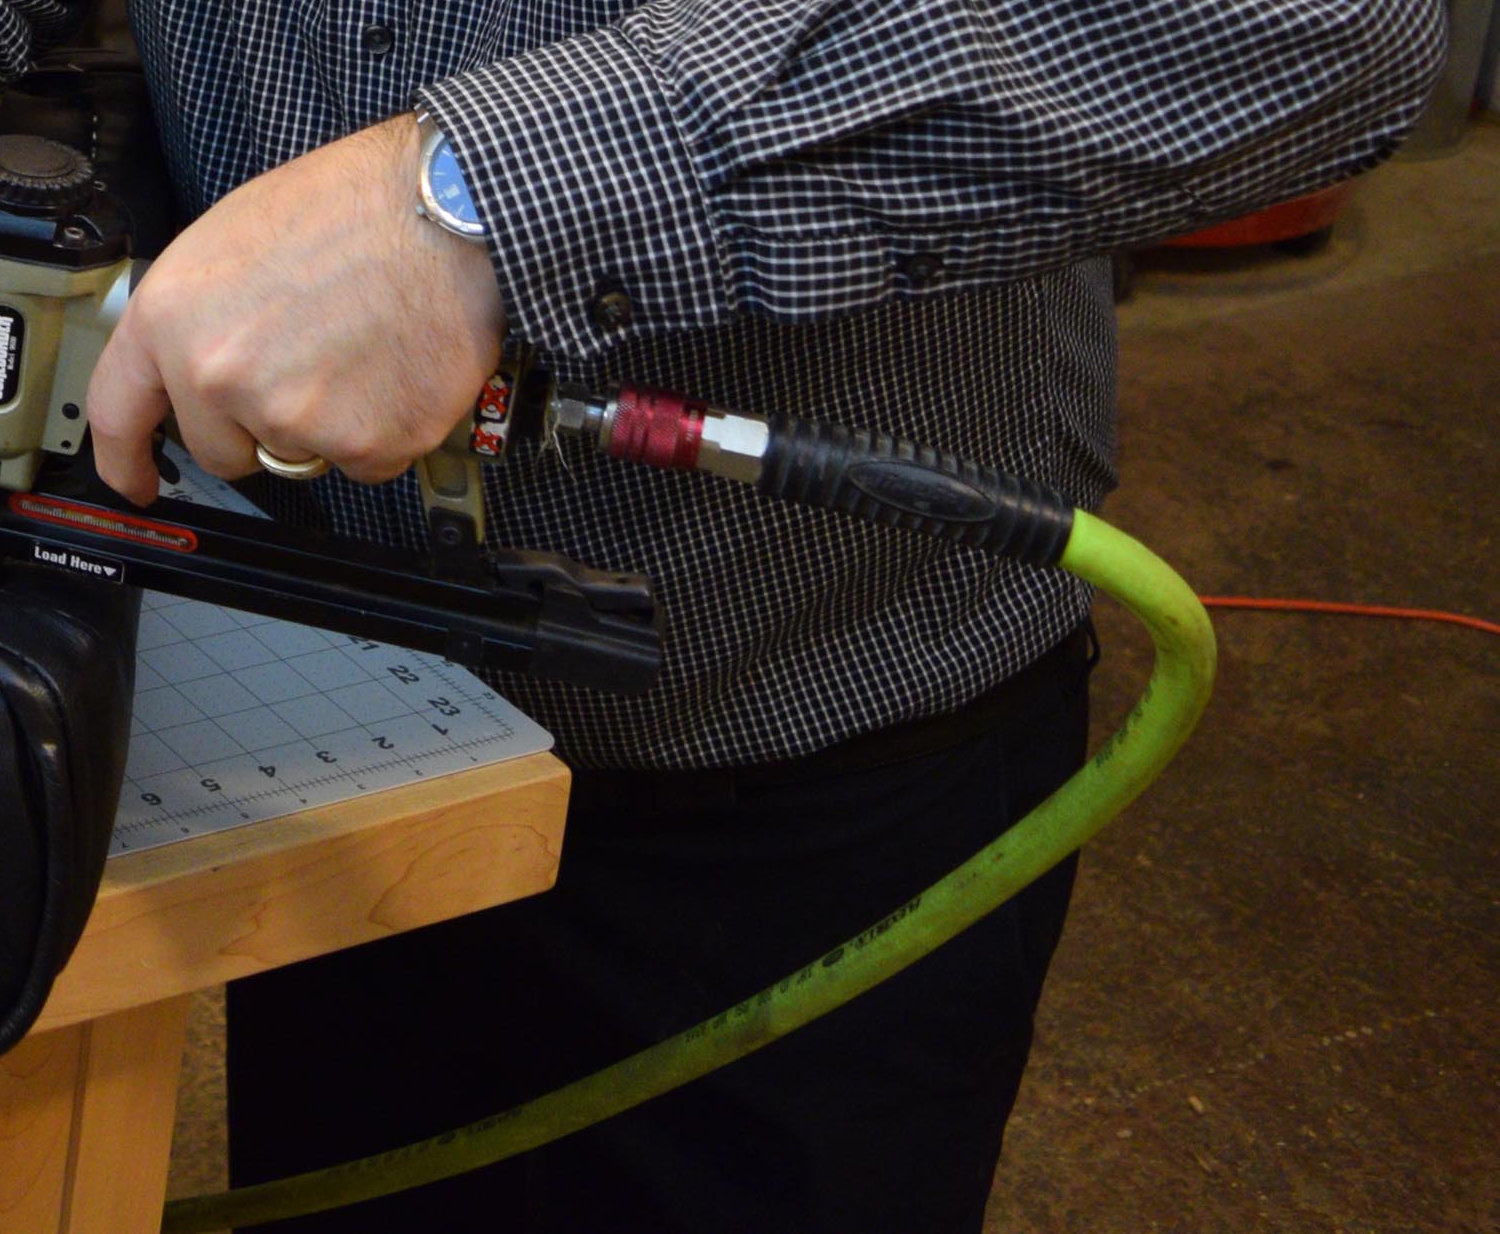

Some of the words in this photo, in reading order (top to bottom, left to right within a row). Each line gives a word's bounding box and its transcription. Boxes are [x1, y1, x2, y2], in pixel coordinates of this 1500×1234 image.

[34, 545, 67, 565] Load
[70, 555, 102, 575] Here
[386, 665, 419, 685] 22
[427, 696, 460, 717] 23
[431, 723, 449, 737] 1
[372, 736, 394, 750] 2
[316, 750, 337, 764] 3
[259, 765, 277, 779] 4
[201, 778, 221, 793] 5
[141, 792, 162, 806] 6
